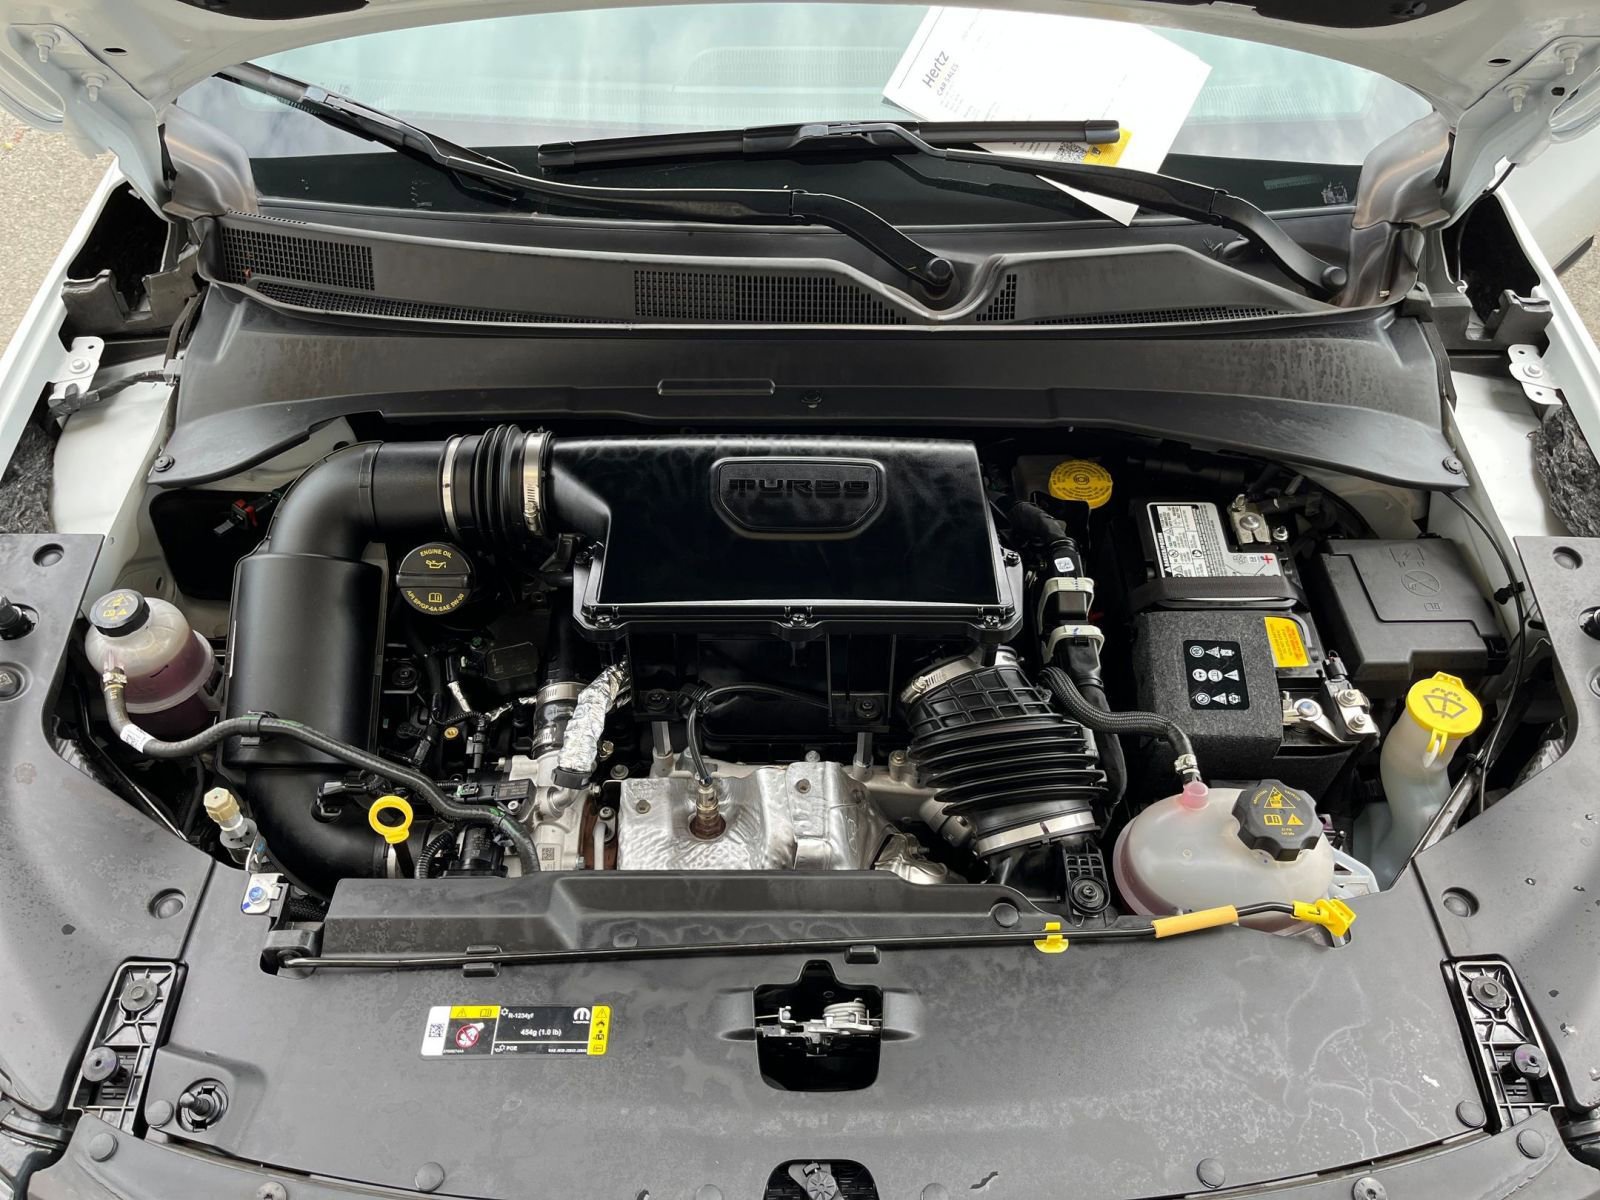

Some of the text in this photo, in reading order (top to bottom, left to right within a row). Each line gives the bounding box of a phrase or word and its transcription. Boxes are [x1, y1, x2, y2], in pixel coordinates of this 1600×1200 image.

[922, 50, 950, 89] Hertz
[944, 63, 960, 83] SALES
[728, 479, 870, 498] TURBO
[420, 549, 452, 559] ENGINE OIL
[508, 1012, 534, 1020] R-1234yf
[520, 1028, 537, 1038] 454g
